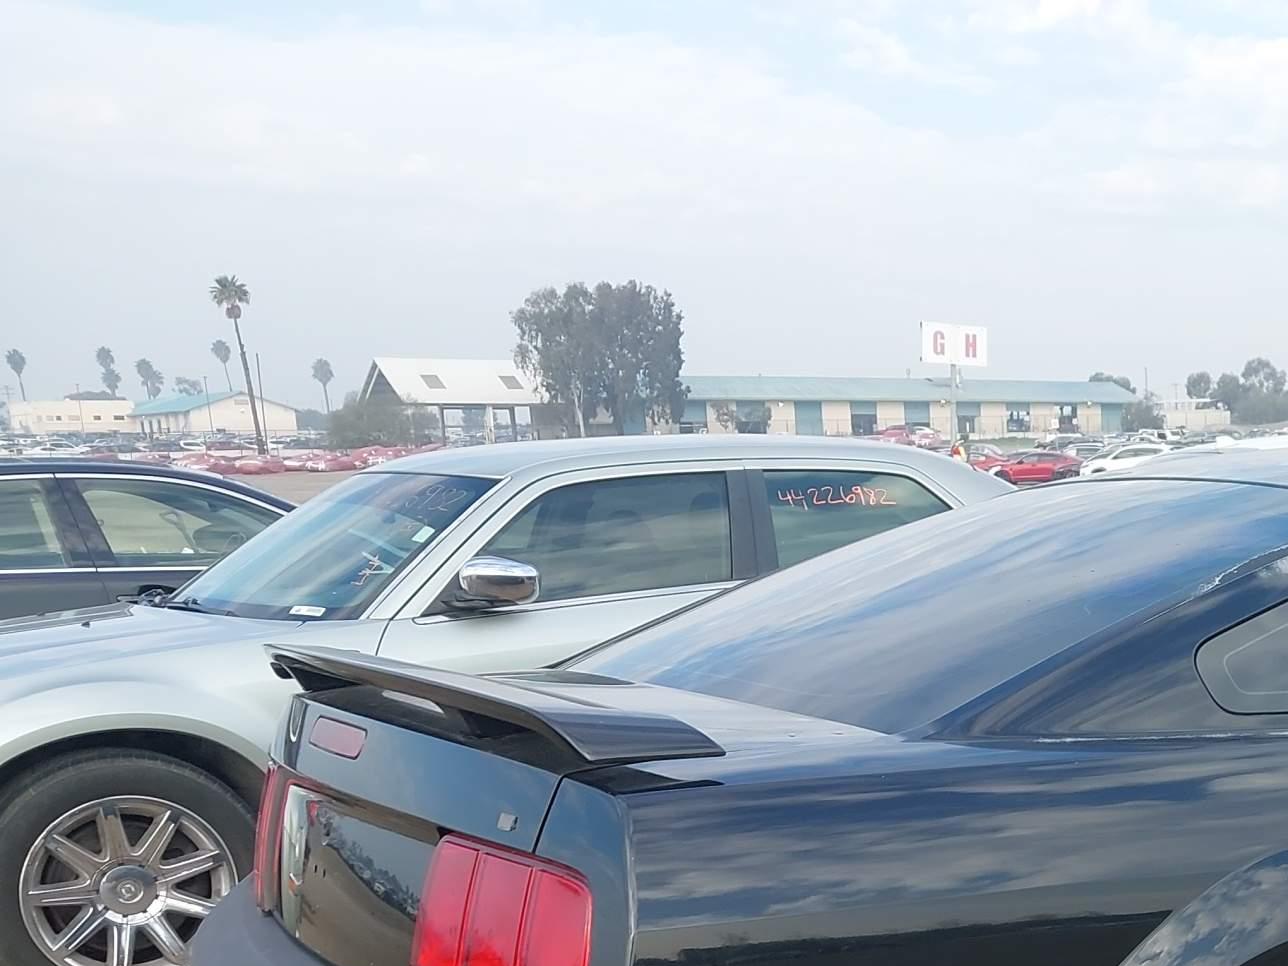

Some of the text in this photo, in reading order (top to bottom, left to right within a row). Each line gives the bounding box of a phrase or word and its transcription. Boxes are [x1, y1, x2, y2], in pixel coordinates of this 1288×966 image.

[933, 330, 977, 358] G H
[777, 485, 897, 511] 44226982
